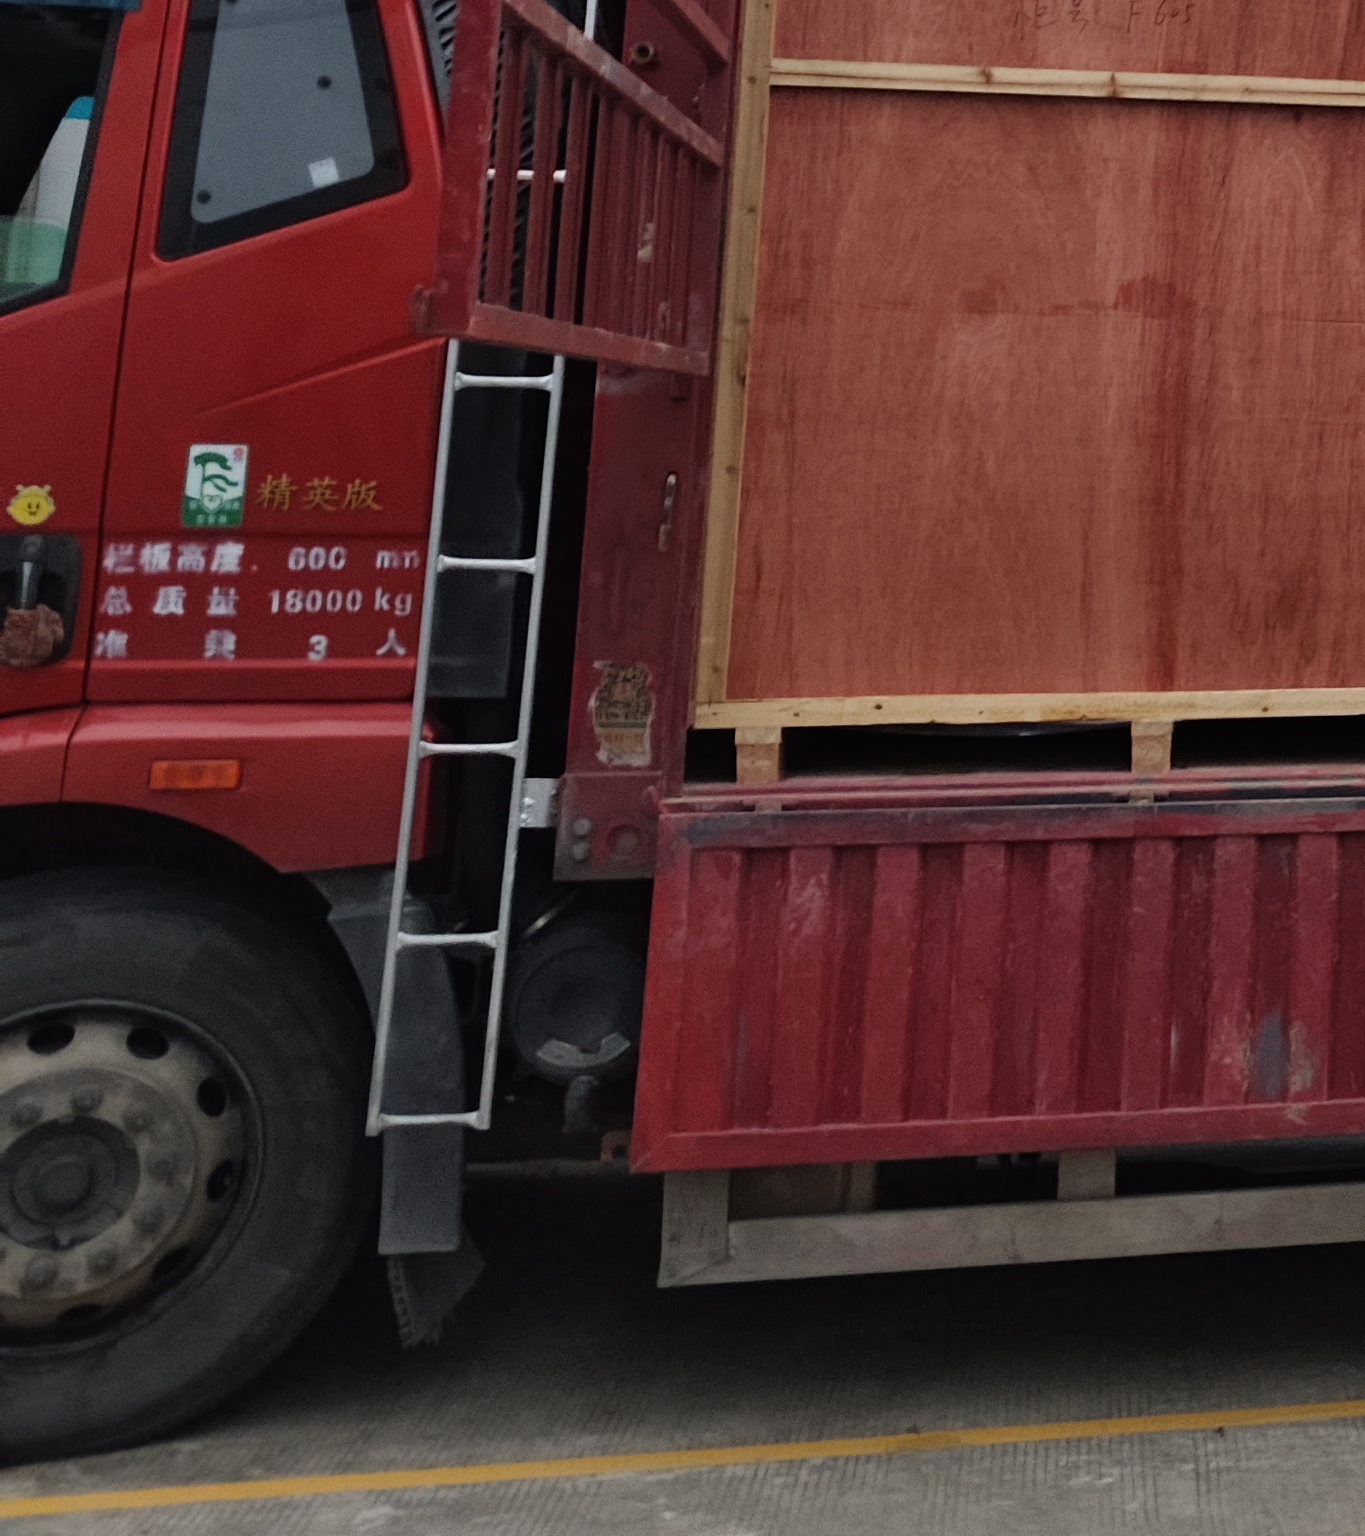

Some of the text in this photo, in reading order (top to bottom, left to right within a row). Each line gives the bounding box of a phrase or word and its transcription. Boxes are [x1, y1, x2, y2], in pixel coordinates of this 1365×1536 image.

[255, 471, 385, 513] 精英版
[267, 588, 364, 615] 18000
[373, 586, 414, 618] kg
[307, 634, 329, 663] 3
